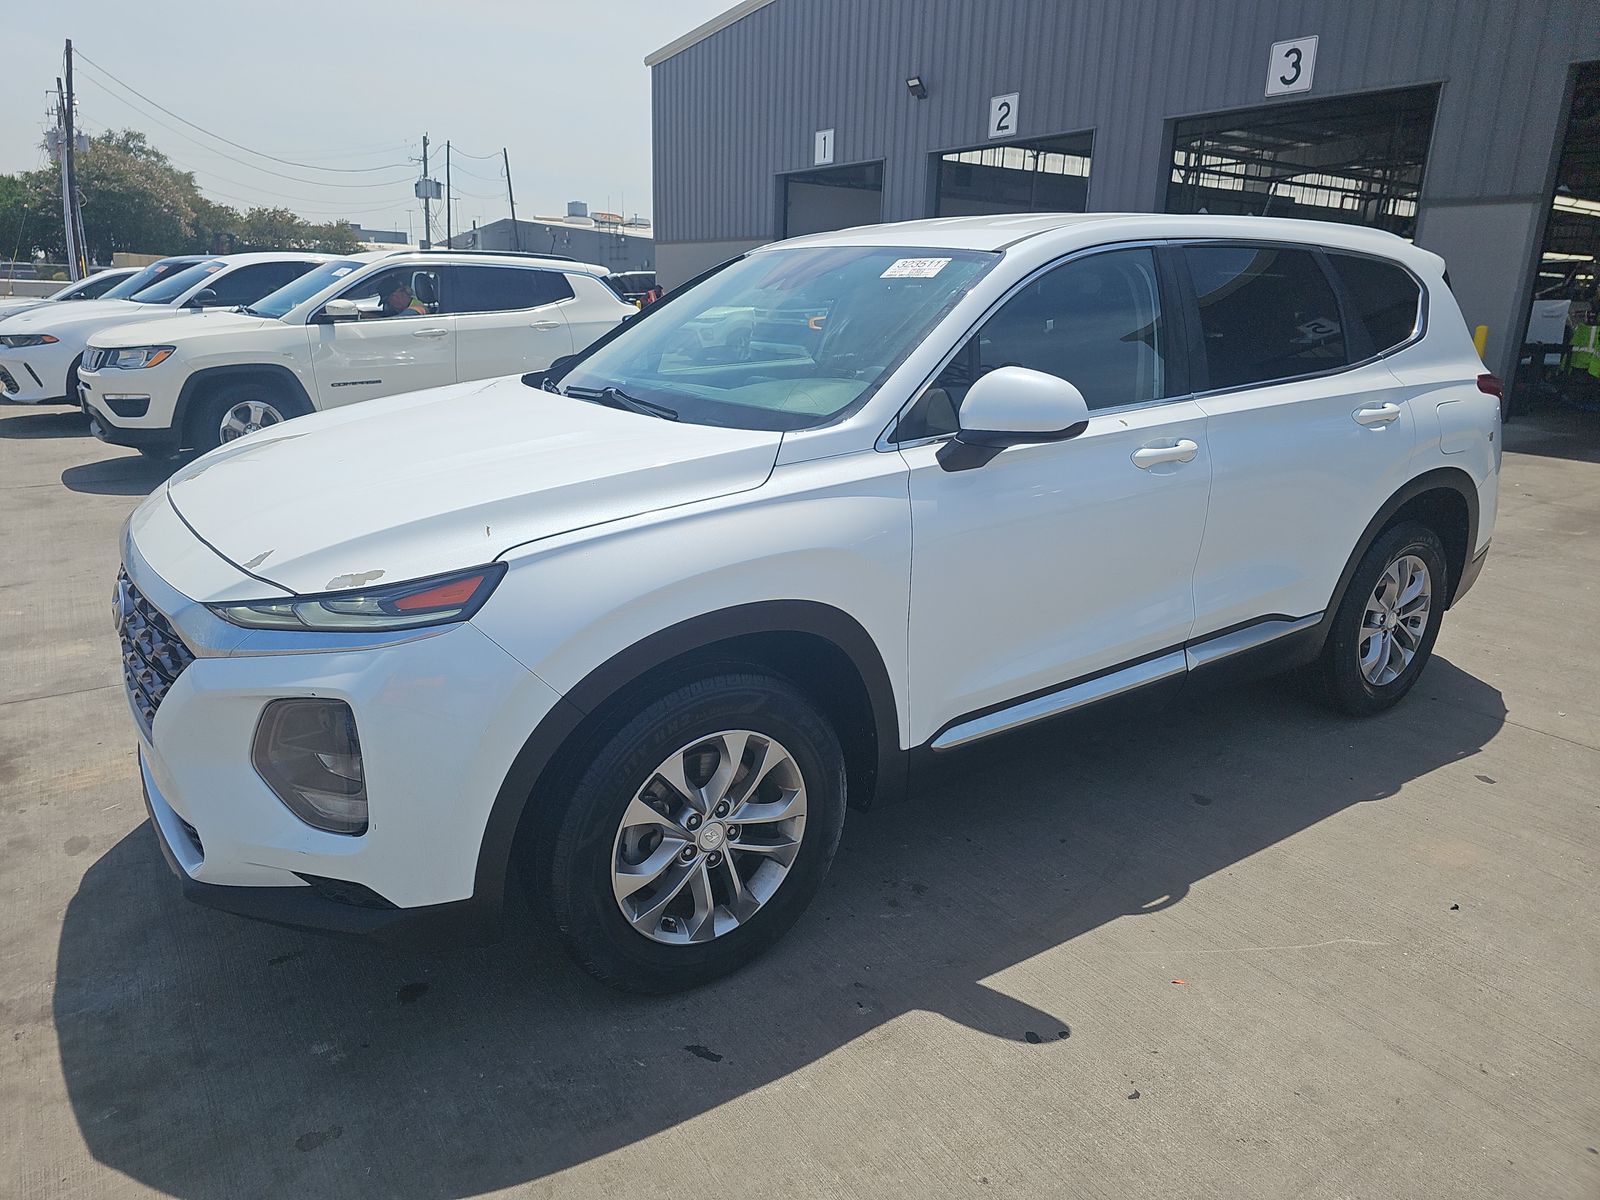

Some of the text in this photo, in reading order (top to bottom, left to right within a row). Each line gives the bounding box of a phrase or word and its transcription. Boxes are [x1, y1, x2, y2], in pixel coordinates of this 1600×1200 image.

[1280, 48, 1303, 86] 3
[996, 102, 1011, 131] 2
[822, 136, 827, 158] 1
